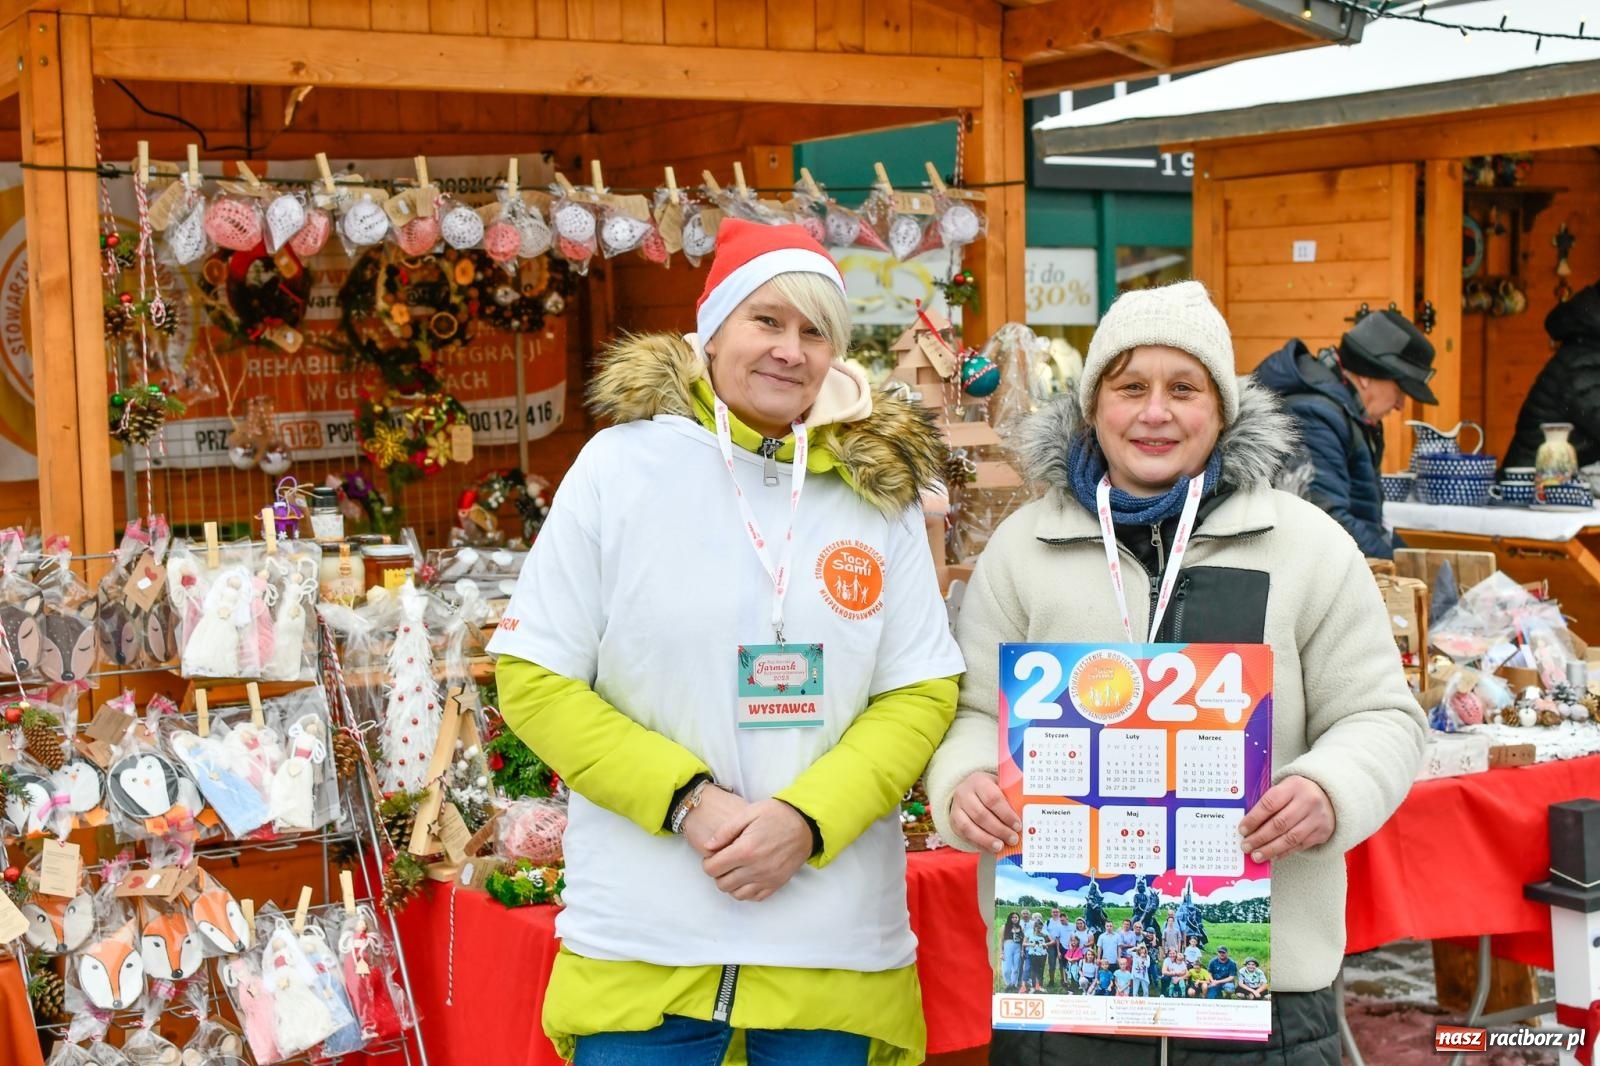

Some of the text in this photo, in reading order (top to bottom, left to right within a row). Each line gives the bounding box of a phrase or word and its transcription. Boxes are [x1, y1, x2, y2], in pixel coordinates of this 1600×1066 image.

[1041, 263, 1065, 284] do
[1026, 280, 1091, 312] 30%
[815, 539, 852, 580] STOWARZYSZENIE
[832, 559, 872, 576] Sami
[840, 551, 870, 567] Tacy
[757, 661, 796, 674] Jarmark
[748, 703, 816, 715] WYSTAWCA
